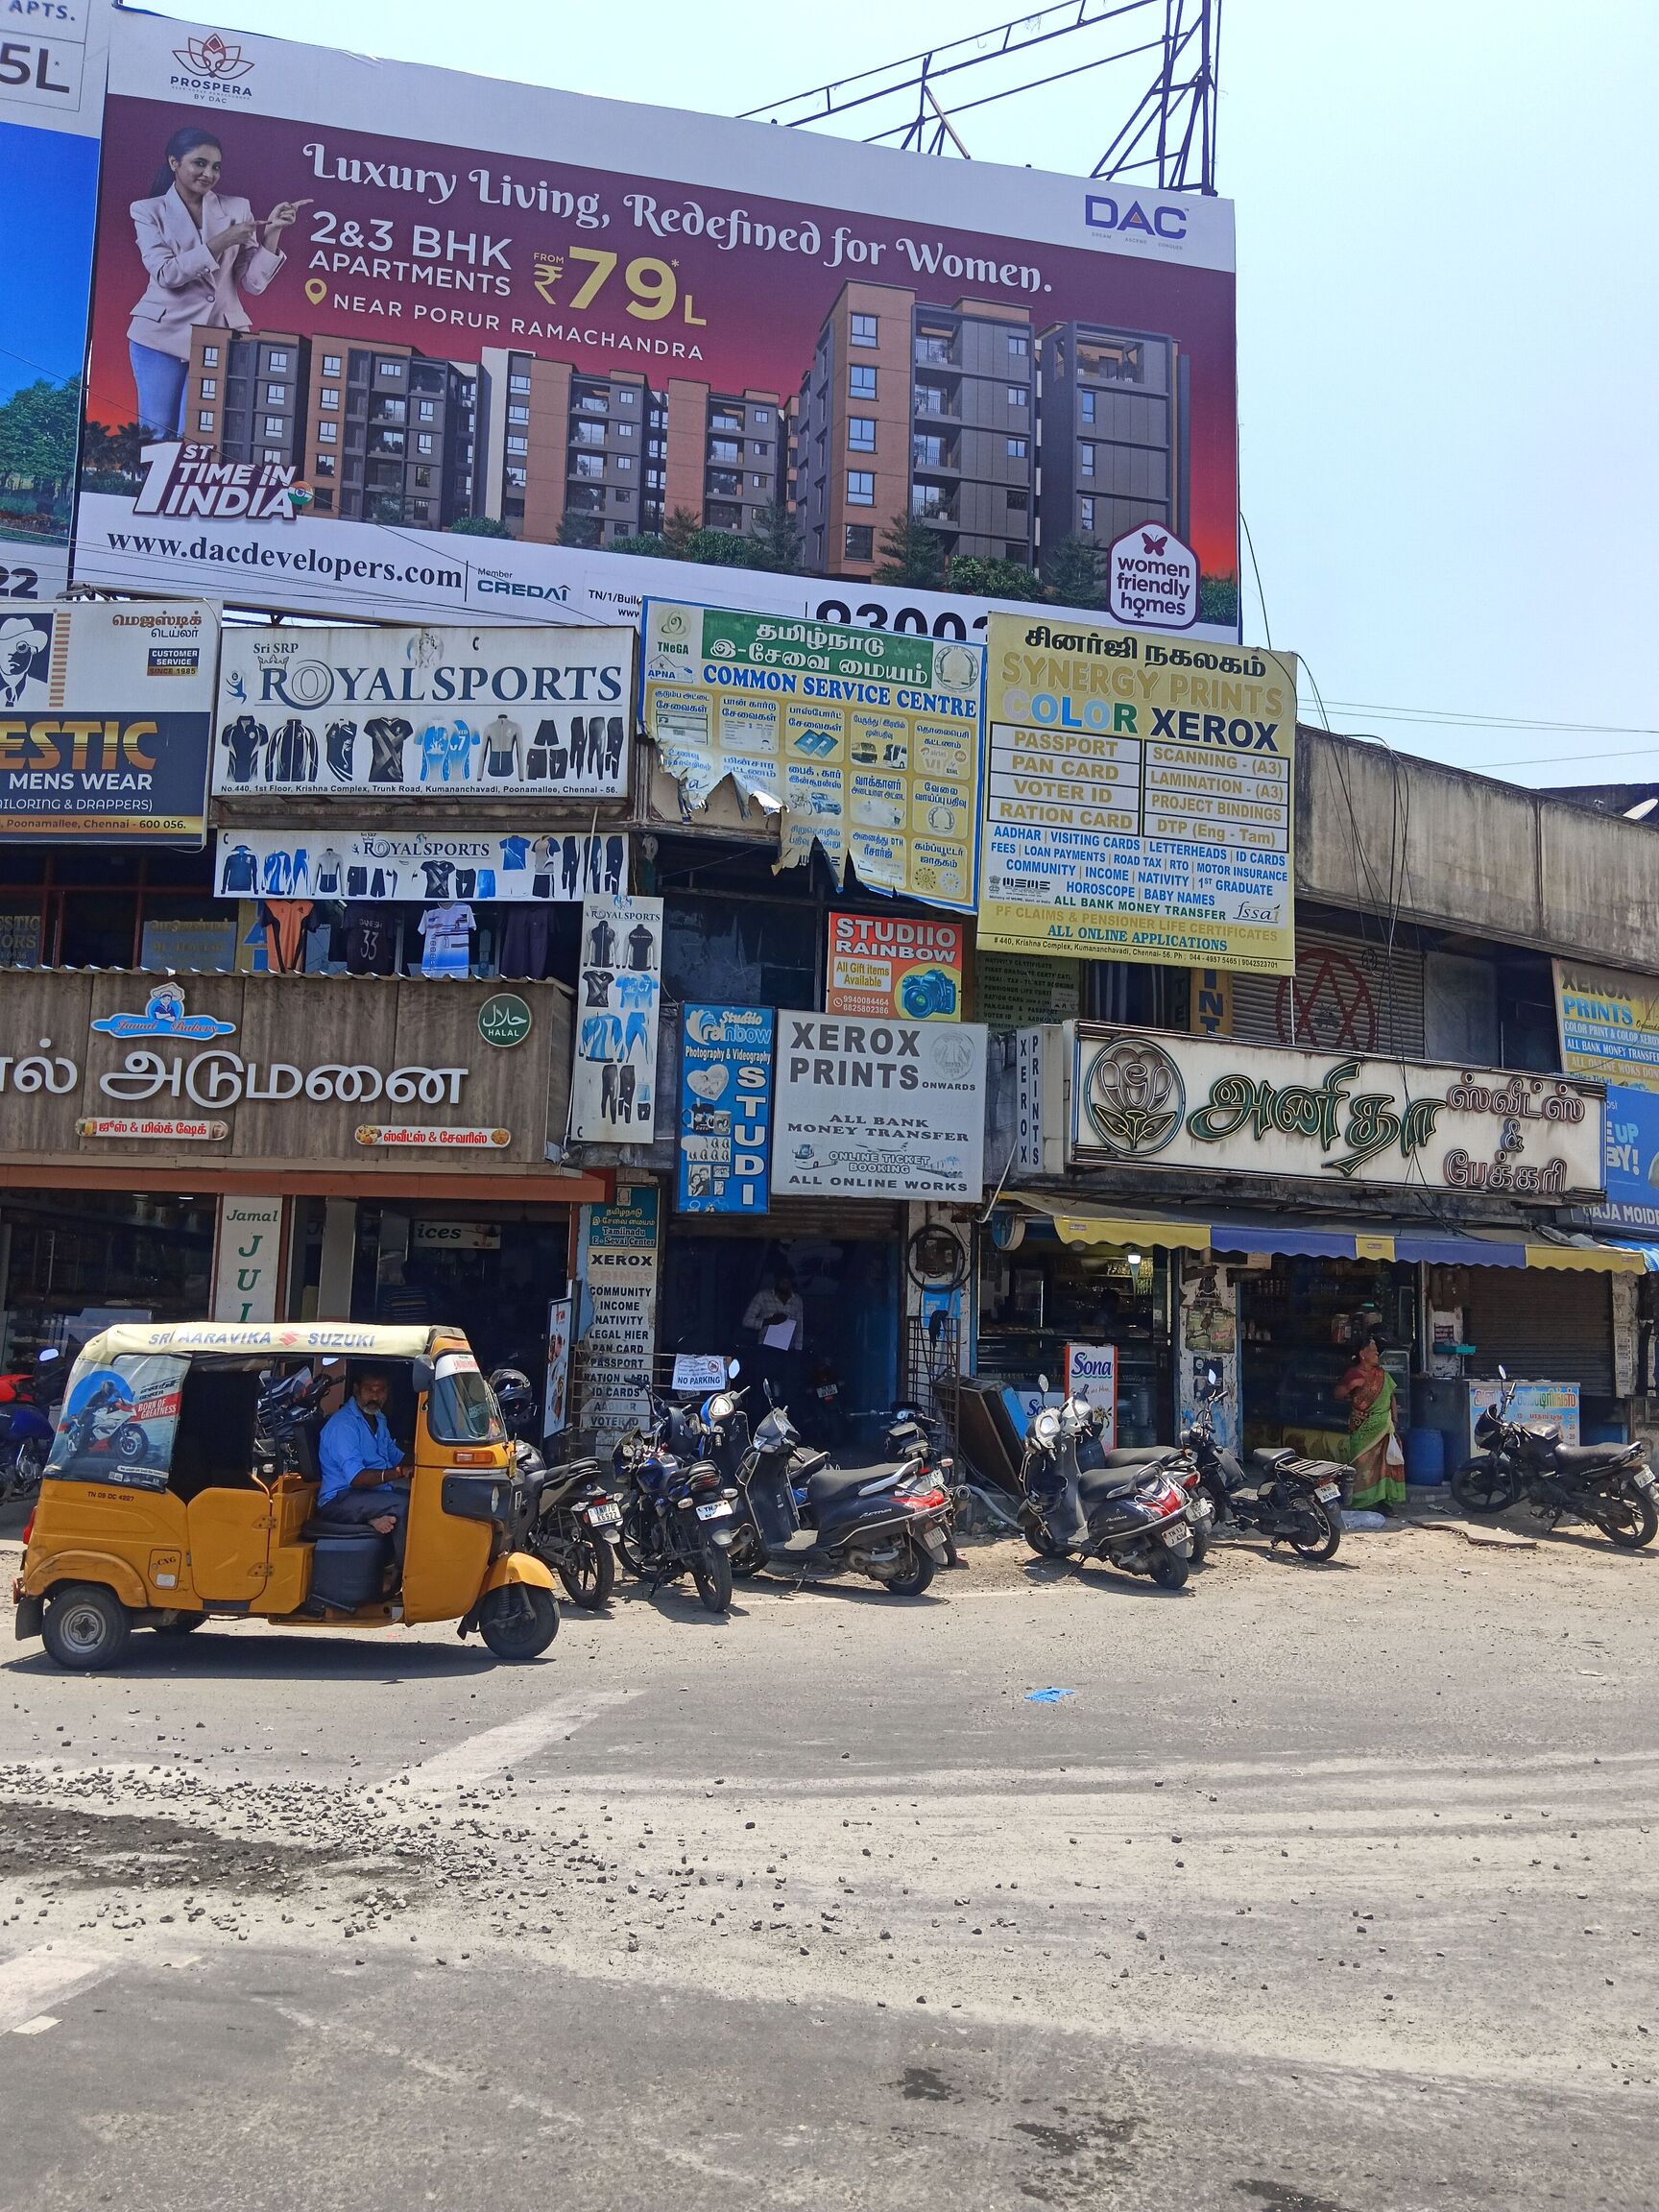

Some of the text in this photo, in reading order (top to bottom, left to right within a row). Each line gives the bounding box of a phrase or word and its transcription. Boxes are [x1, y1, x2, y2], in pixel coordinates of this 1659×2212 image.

[9, 0, 75, 21] APTS.
[170, 76, 252, 96] PROSPERA
[302, 143, 1052, 293] Luxury Living, Redefined for Women.
[1086, 195, 1187, 239] DAC
[310, 210, 513, 269] 2&3 BHK
[534, 252, 564, 264] FROM
[309, 250, 511, 296] APARTMENTS
[333, 294, 703, 360] NEAR PORUR RAMACHANDRA
[179, 462, 297, 487] TIME IN
[164, 484, 294, 519] INDIA
[108, 530, 461, 589] www.dacdevelopers.com
[1118, 557, 1190, 578] women
[478, 568, 513, 578] Member
[1117, 572, 1190, 600] friendly
[1121, 592, 1185, 615] homes
[273, 642, 299, 654] SRP
[658, 641, 688, 655] TNeGA
[756, 623, 885, 657] தமிழ்நாடு
[1024, 625, 1266, 678] சினர்ஜி நகலகம்
[648, 669, 675, 679] APNA
[839, 659, 927, 685] மையம்
[703, 664, 976, 719] COMMON SERVICE CENTRE
[1000, 651, 1284, 718] SYNERGY PRINTS
[723, 698, 777, 711] பான் கார்டு
[1002, 689, 1278, 752] COLOR XEROX
[0, 721, 157, 769] ESTIC
[1014, 730, 1118, 757] PASSPORT
[1153, 746, 1238, 769] SCANNING
[1061, 760, 1119, 781] CARD
[9, 773, 152, 790] MENS WEAR
[399, 785, 422, 794] Road,
[925, 782, 958, 795] வேலை
[1014, 779, 1085, 801] VOTER
[1151, 771, 1242, 795] LAMINATION
[77, 799, 152, 811] DRAPPERS)
[1152, 794, 1282, 822] PROJECT BINDINGS
[7, 819, 186, 829] Poonamallee, Chennai 600 056.
[999, 802, 1133, 830] RATION CARD
[994, 826, 1227, 859] AADHAR VISITING CARDS LETTERHEADS
[1054, 849, 1287, 882] PAYMENTS INSURANCE
[1006, 859, 1273, 896] COMMUNITY INCOME NATIVITY GRADUATE
[1067, 881, 1135, 898] HOROSCOPE
[1165, 905, 1226, 921] TRANSFER
[836, 918, 956, 947] STUDIIO
[1078, 927, 1228, 951] ONLINE APPLICATIONS
[835, 940, 956, 963] RAINBOW
[1016, 939, 1041, 948] Krishna
[866, 964, 889, 976] items
[844, 974, 881, 988] Available
[1563, 996, 1633, 1026] PRINTS
[1564, 1021, 1608, 1037] COLOR PRINT
[790, 1022, 922, 1057] XEROX
[1567, 1039, 1626, 1057] ALL BANK MONEY
[685, 1045, 771, 1065] Photography Videography
[1572, 1057, 1586, 1067] ALL
[99, 1048, 469, 1109] அடுமனை
[790, 1057, 919, 1091] PRINTS
[922, 1081, 976, 1092] ONWARDS
[1446, 1071, 1586, 1124] ஸ்வீட்ஸ்
[830, 1115, 929, 1128] ALL BANK
[1189, 1060, 1446, 1176] அனிதா
[787, 1123, 970, 1142] MONEY TRANSFER
[1503, 1118, 1525, 1154] &
[1615, 1122, 1639, 1143] UP
[829, 1151, 930, 1166] ONLINE TICKET
[849, 1163, 911, 1174] BOOKING
[1443, 1150, 1567, 1193] பேக்கரி
[789, 1175, 968, 1192] ALL ONLINE WORKS
[226, 1209, 277, 1222] Jamal
[418, 1223, 462, 1239] ices
[602, 1227, 645, 1236] Tamilnadu
[629, 1238, 656, 1246] Center
[591, 1255, 653, 1266] XEROX
[590, 1286, 652, 1297] COMMUNITY
[600, 1301, 639, 1310] INCOME
[595, 1315, 643, 1325] NATIVITY
[308, 1333, 374, 1347] SUZUKI
[589, 1330, 648, 1339] LEGAL HIER
[590, 1359, 643, 1368] PASSPORT
[1071, 1352, 1113, 1380] Sona
[584, 1374, 620, 1382] RATION
[690, 1376, 720, 1384] PARKING
[138, 1398, 165, 1411] BORN OF
[140, 1405, 177, 1420] GREATNESS
